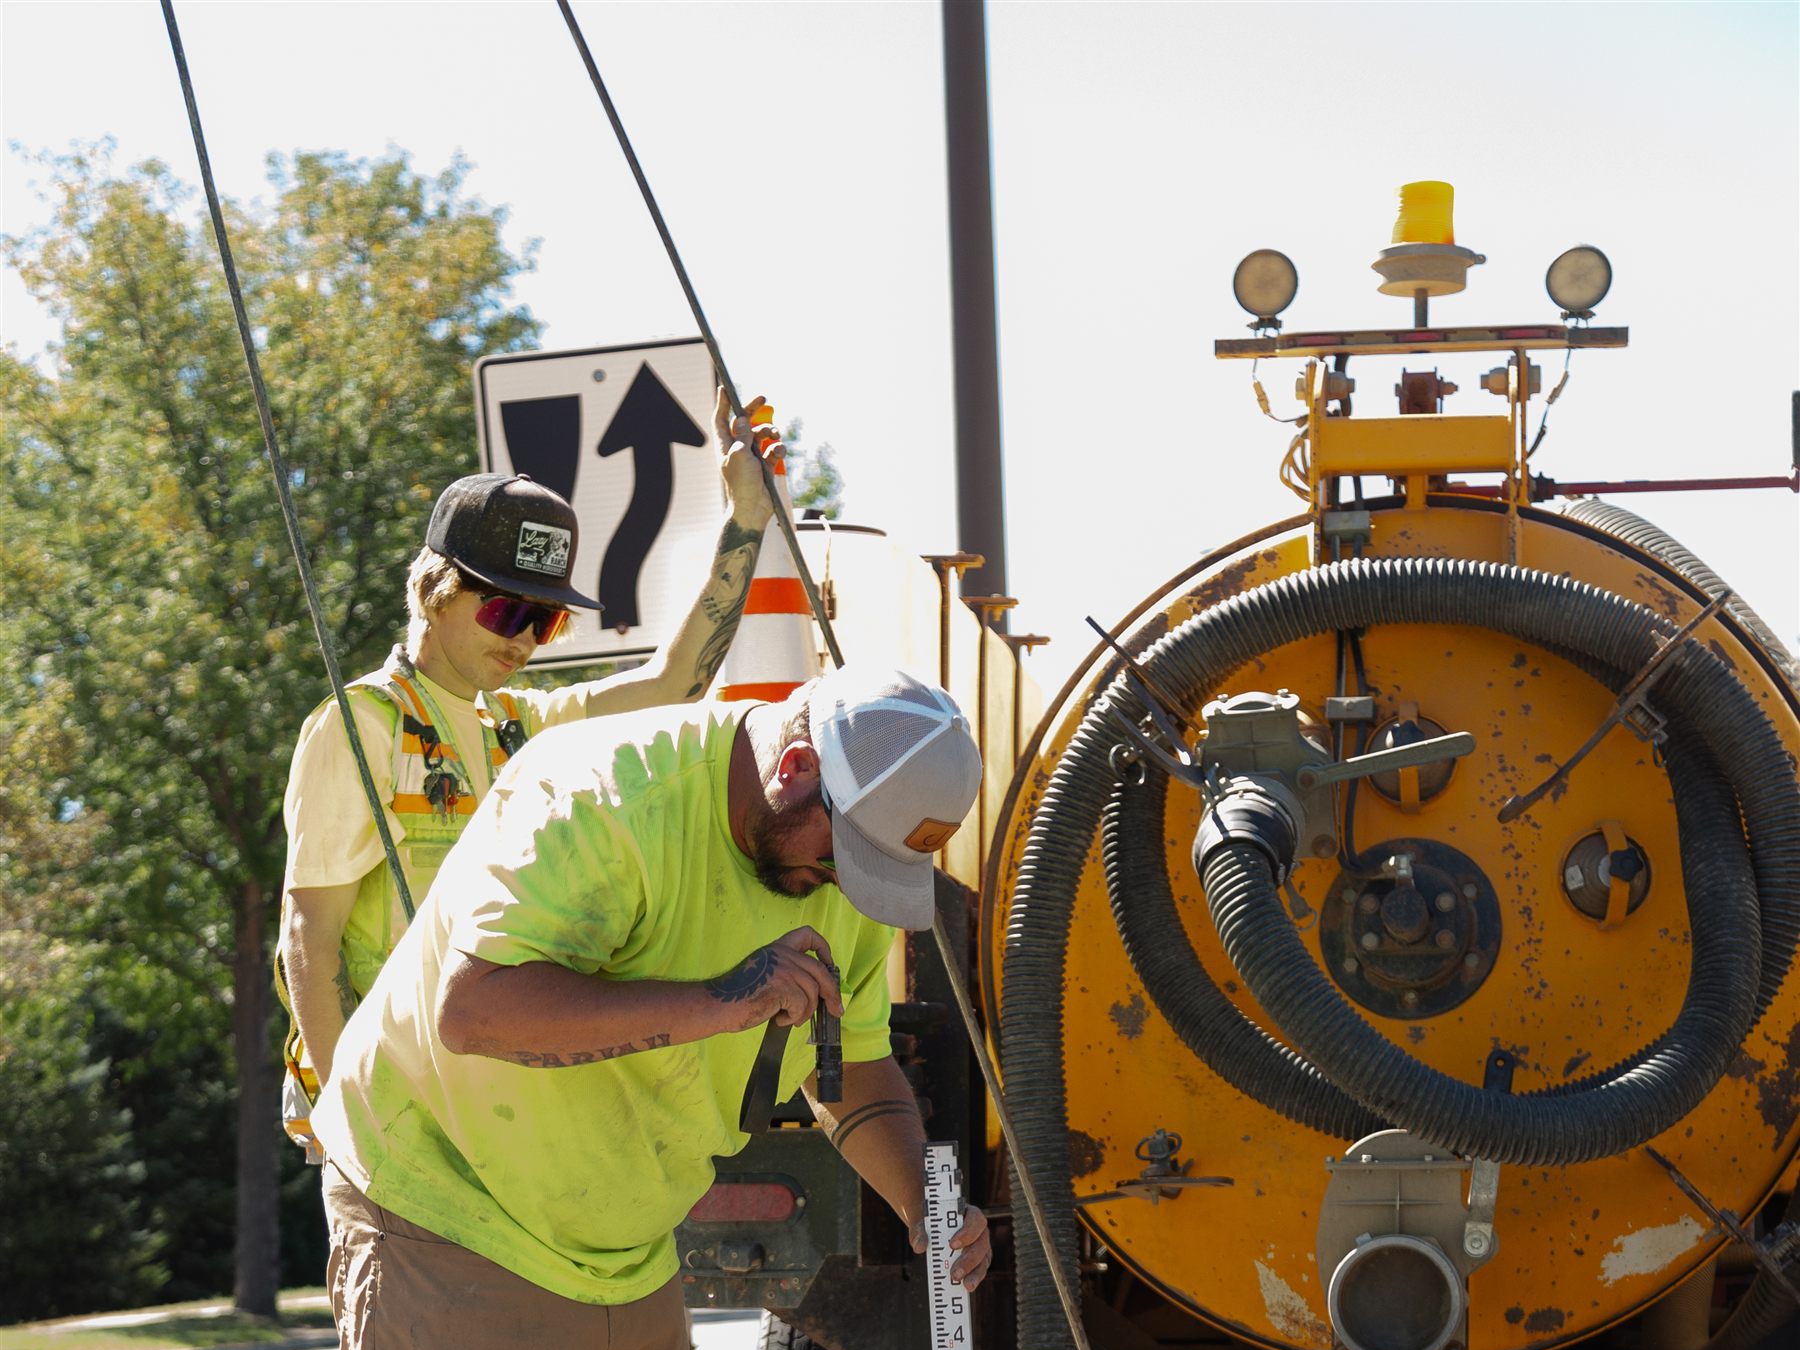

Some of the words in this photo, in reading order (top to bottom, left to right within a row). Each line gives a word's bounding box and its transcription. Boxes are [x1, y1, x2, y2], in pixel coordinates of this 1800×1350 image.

[947, 1210, 959, 1229] 8
[952, 1296, 963, 1315] 5
[953, 1325, 965, 1344] 4
